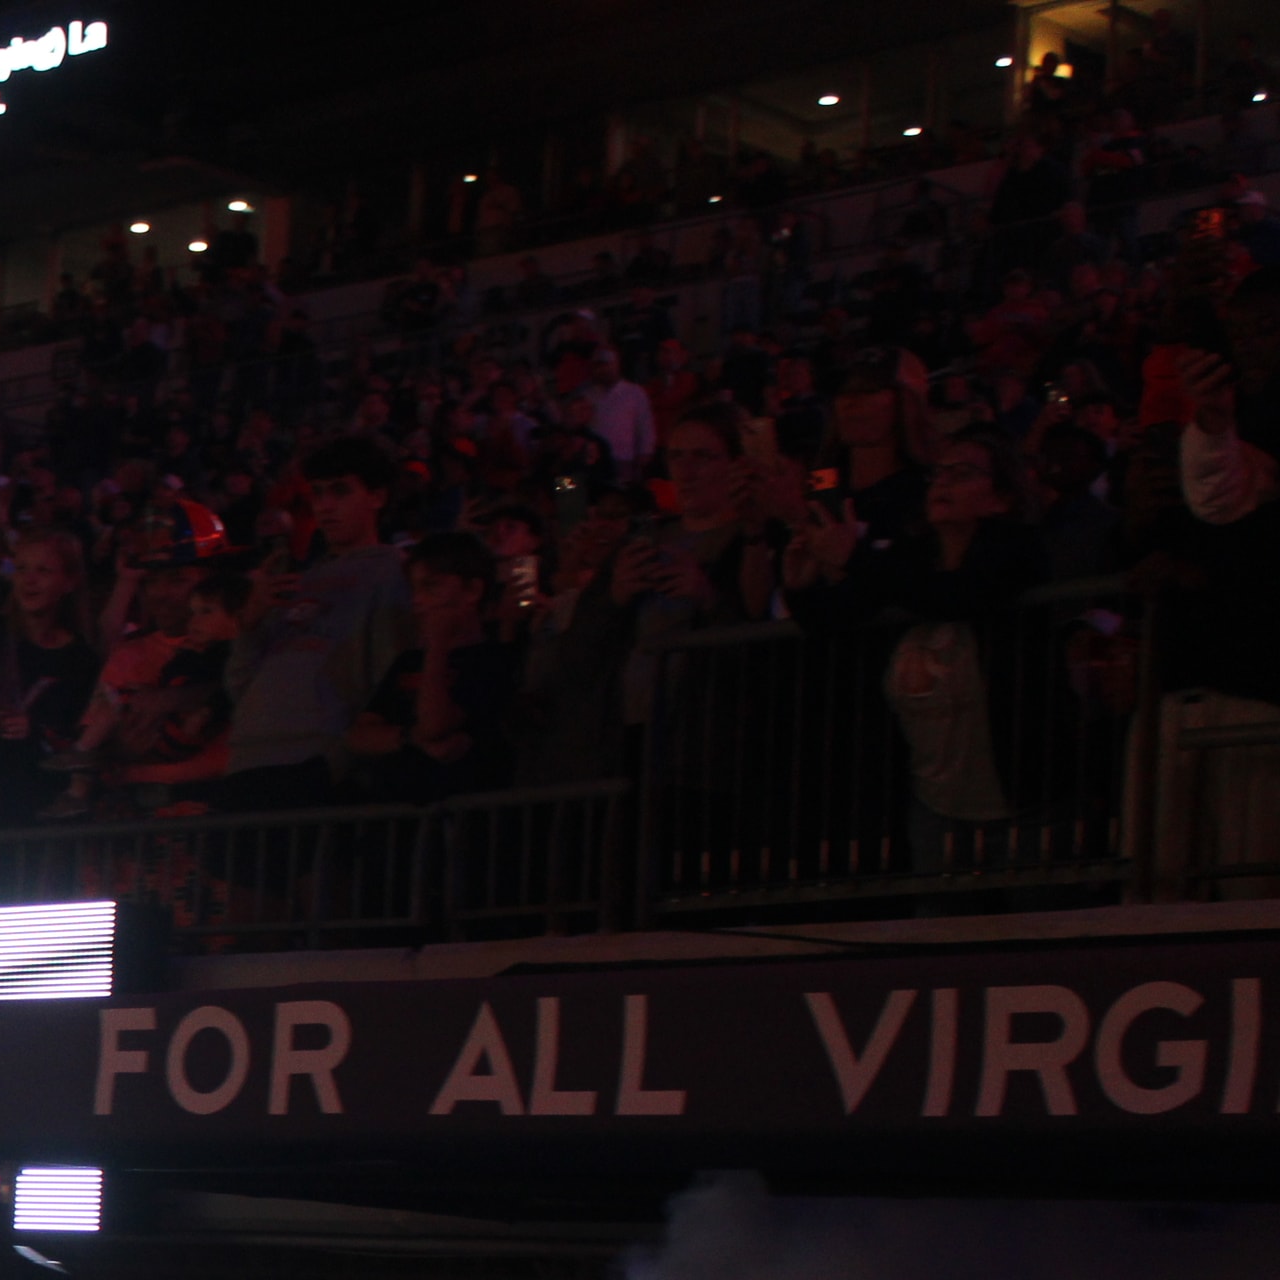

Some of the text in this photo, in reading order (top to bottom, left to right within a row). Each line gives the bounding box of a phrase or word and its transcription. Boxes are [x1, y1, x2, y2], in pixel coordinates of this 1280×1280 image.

[92, 977, 1280, 1117] FOR ALL VIRGI
